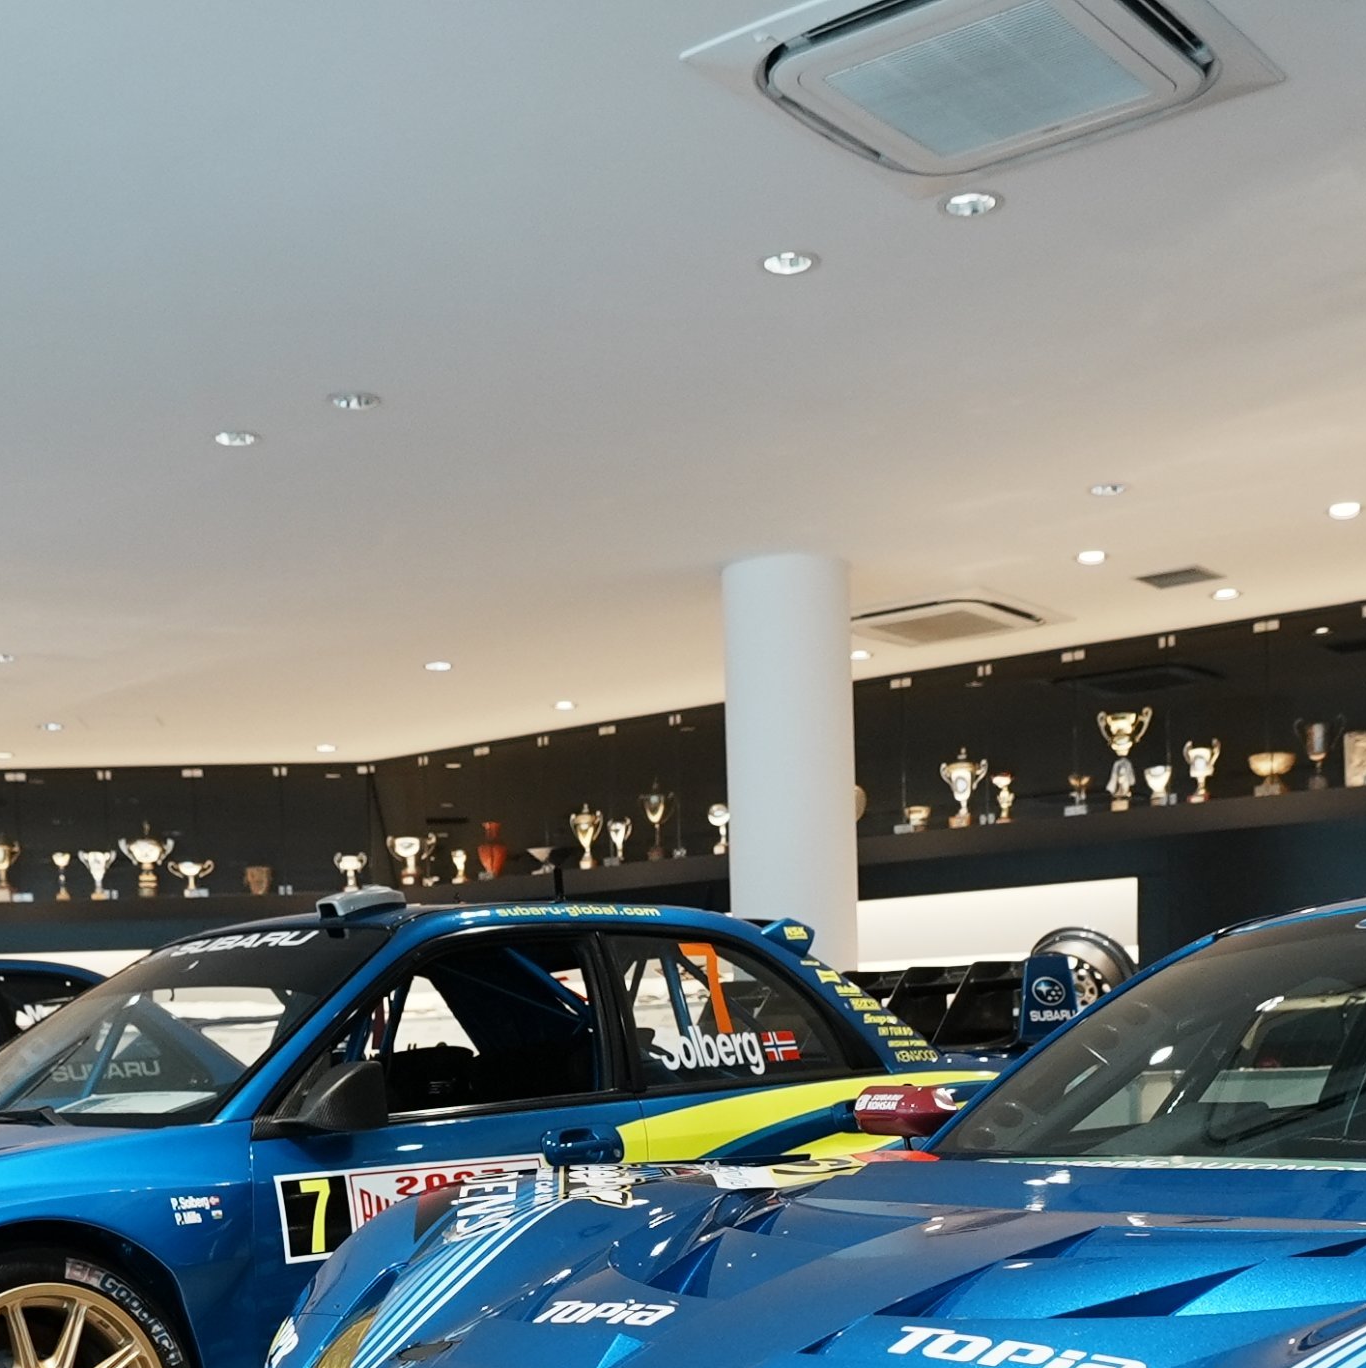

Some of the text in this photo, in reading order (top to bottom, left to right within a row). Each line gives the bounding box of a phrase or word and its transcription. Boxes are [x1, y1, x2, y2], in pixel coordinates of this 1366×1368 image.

[496, 904, 662, 918] subaru-global.com
[171, 930, 319, 958] SUBARU
[680, 943, 733, 1034] 7
[1030, 1009, 1077, 1022] SUBARU
[657, 1026, 766, 1075] Solberg
[52, 1059, 161, 1083] SUBARU
[299, 1179, 331, 1253] 7
